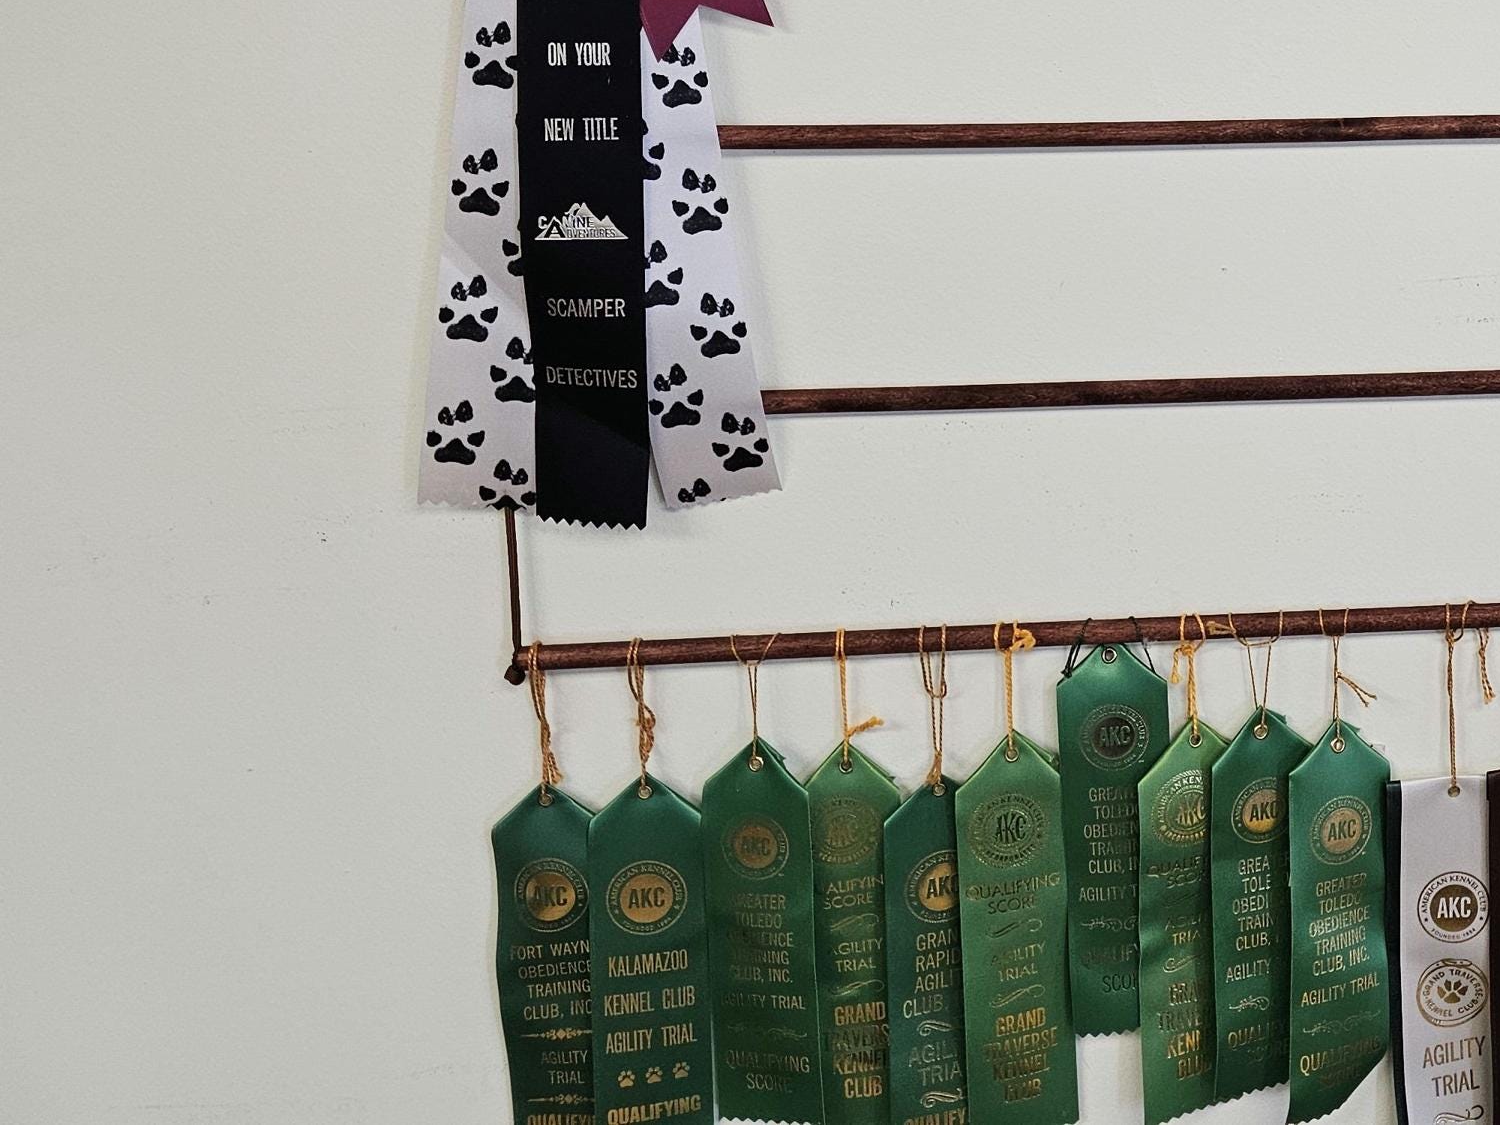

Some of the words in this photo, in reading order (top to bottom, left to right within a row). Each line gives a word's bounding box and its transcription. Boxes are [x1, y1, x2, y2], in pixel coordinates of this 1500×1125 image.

[547, 42, 569, 66] ON
[575, 41, 611, 66] YOUR
[544, 117, 574, 142] NEW
[584, 117, 620, 141] TITLE
[547, 297, 626, 318] SCAMPER
[545, 365, 638, 389] DETECTIVES
[1099, 725, 1131, 748] AKC
[1327, 819, 1357, 843] AKC
[533, 886, 568, 907] AKC
[965, 871, 1060, 901] QUALIFYING
[1079, 886, 1127, 903] AGILITY
[1316, 873, 1367, 897] GREATER
[1421, 875, 1448, 914] AMERICAN
[1449, 874, 1479, 892] KENNEL
[1477, 889, 1488, 912] CLUB
[628, 887, 665, 909] AKC
[824, 892, 873, 910] SCORE
[987, 896, 1036, 915] SCORE
[1319, 895, 1361, 916] TOLEDO
[1437, 896, 1472, 919] AKC
[1309, 905, 1370, 938] OBEDIENCE
[550, 939, 590, 958] WAYN
[916, 930, 957, 952] GRAN
[1235, 932, 1271, 952] CLUB,
[1315, 926, 1366, 956] TRAINING
[608, 949, 688, 978] KALAMAZOO
[836, 957, 877, 973] TRIAL
[916, 952, 960, 972] RAPID
[1312, 955, 1346, 976] CLUB,
[1349, 947, 1370, 966] INC.
[527, 979, 591, 999] TRAINING
[1301, 984, 1346, 1008] AGILITY
[1351, 971, 1380, 995] TRIAL
[1422, 970, 1446, 996] GRAND
[523, 1005, 564, 1021] CLUB,
[604, 991, 654, 1017] KENNEL
[662, 985, 696, 1010] CLUB
[771, 995, 806, 1010] TRIAL
[1457, 997, 1480, 1015] CLUB
[834, 1001, 886, 1026] GRAND
[996, 1006, 1046, 1037] GRAND
[605, 1028, 653, 1055] AGILITY
[661, 1022, 697, 1046] TRIAL
[541, 1050, 588, 1065] AGILITY
[1422, 1035, 1487, 1070] AGILITY
[548, 1070, 585, 1084] TRIAL
[918, 1060, 962, 1087] TRIA
[1431, 1069, 1481, 1097] TRIAL
[844, 1075, 883, 1099] CLUB
[607, 1094, 701, 1125] QUALIFYING
